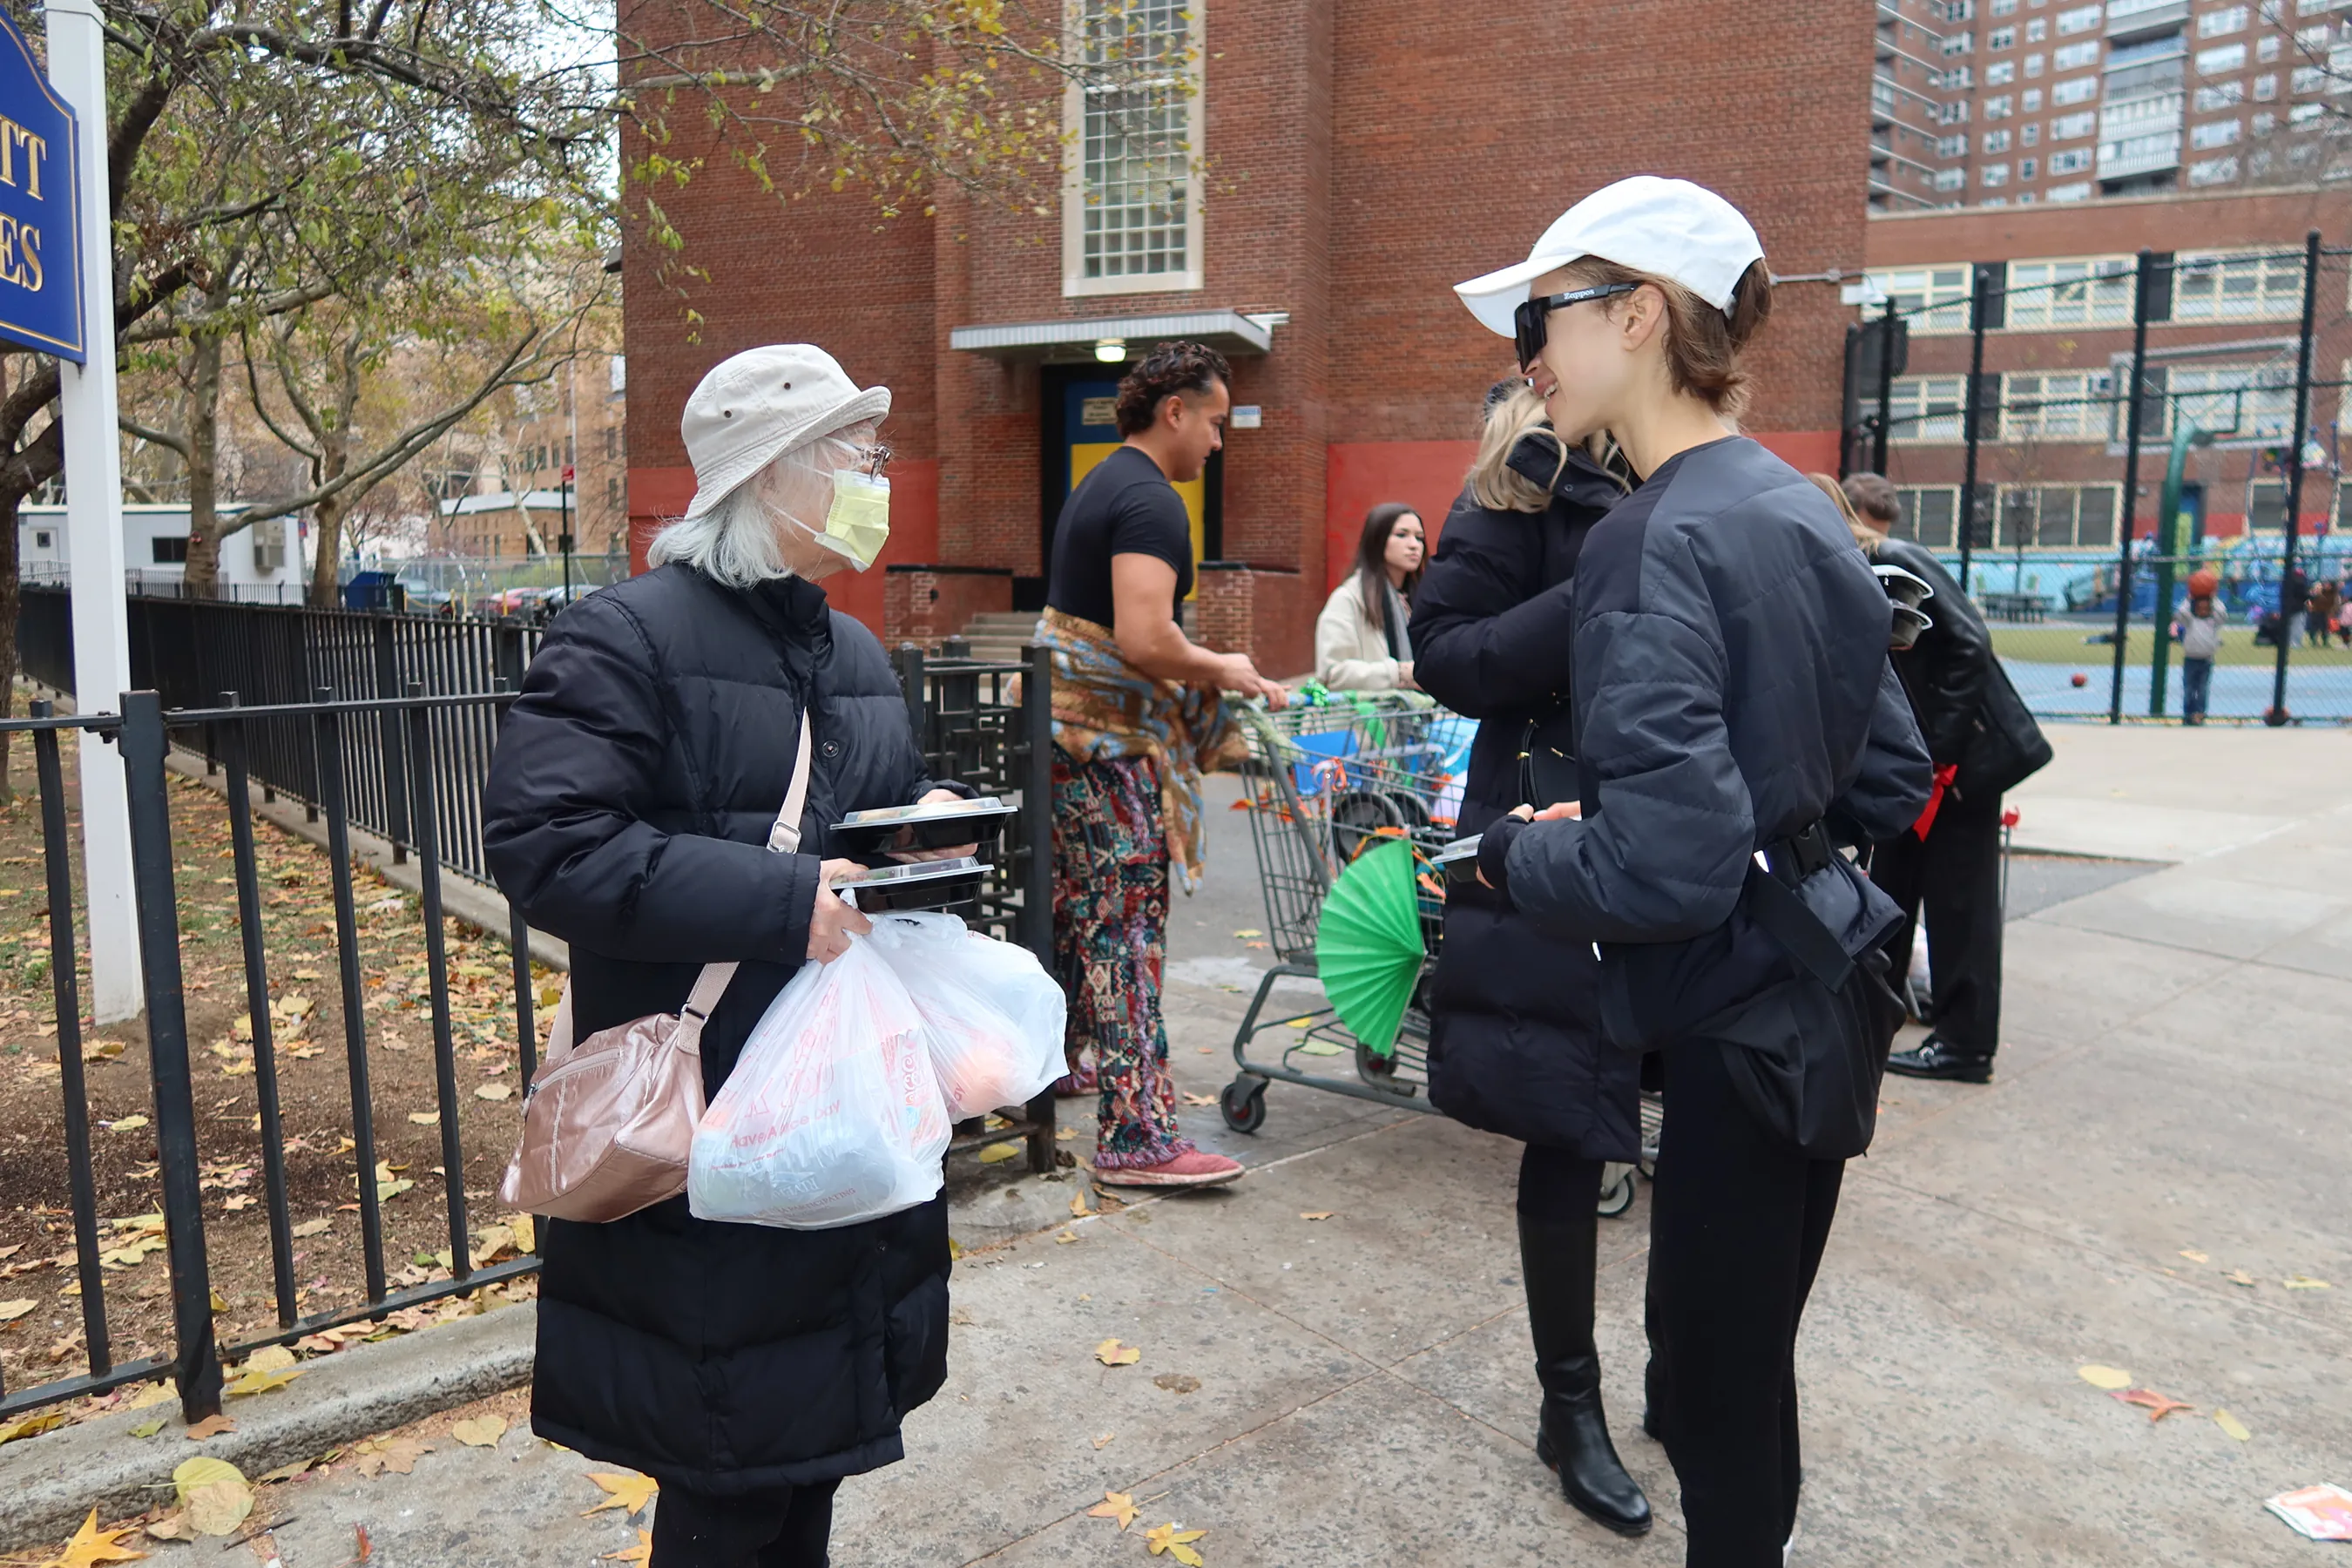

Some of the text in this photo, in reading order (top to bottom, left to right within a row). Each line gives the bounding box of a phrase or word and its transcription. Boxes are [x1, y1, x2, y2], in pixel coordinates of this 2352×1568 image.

[0, 113, 46, 201] TT
[0, 212, 43, 292] ES
[1564, 288, 1595, 300] Zappos
[814, 1099, 840, 1120] Day
